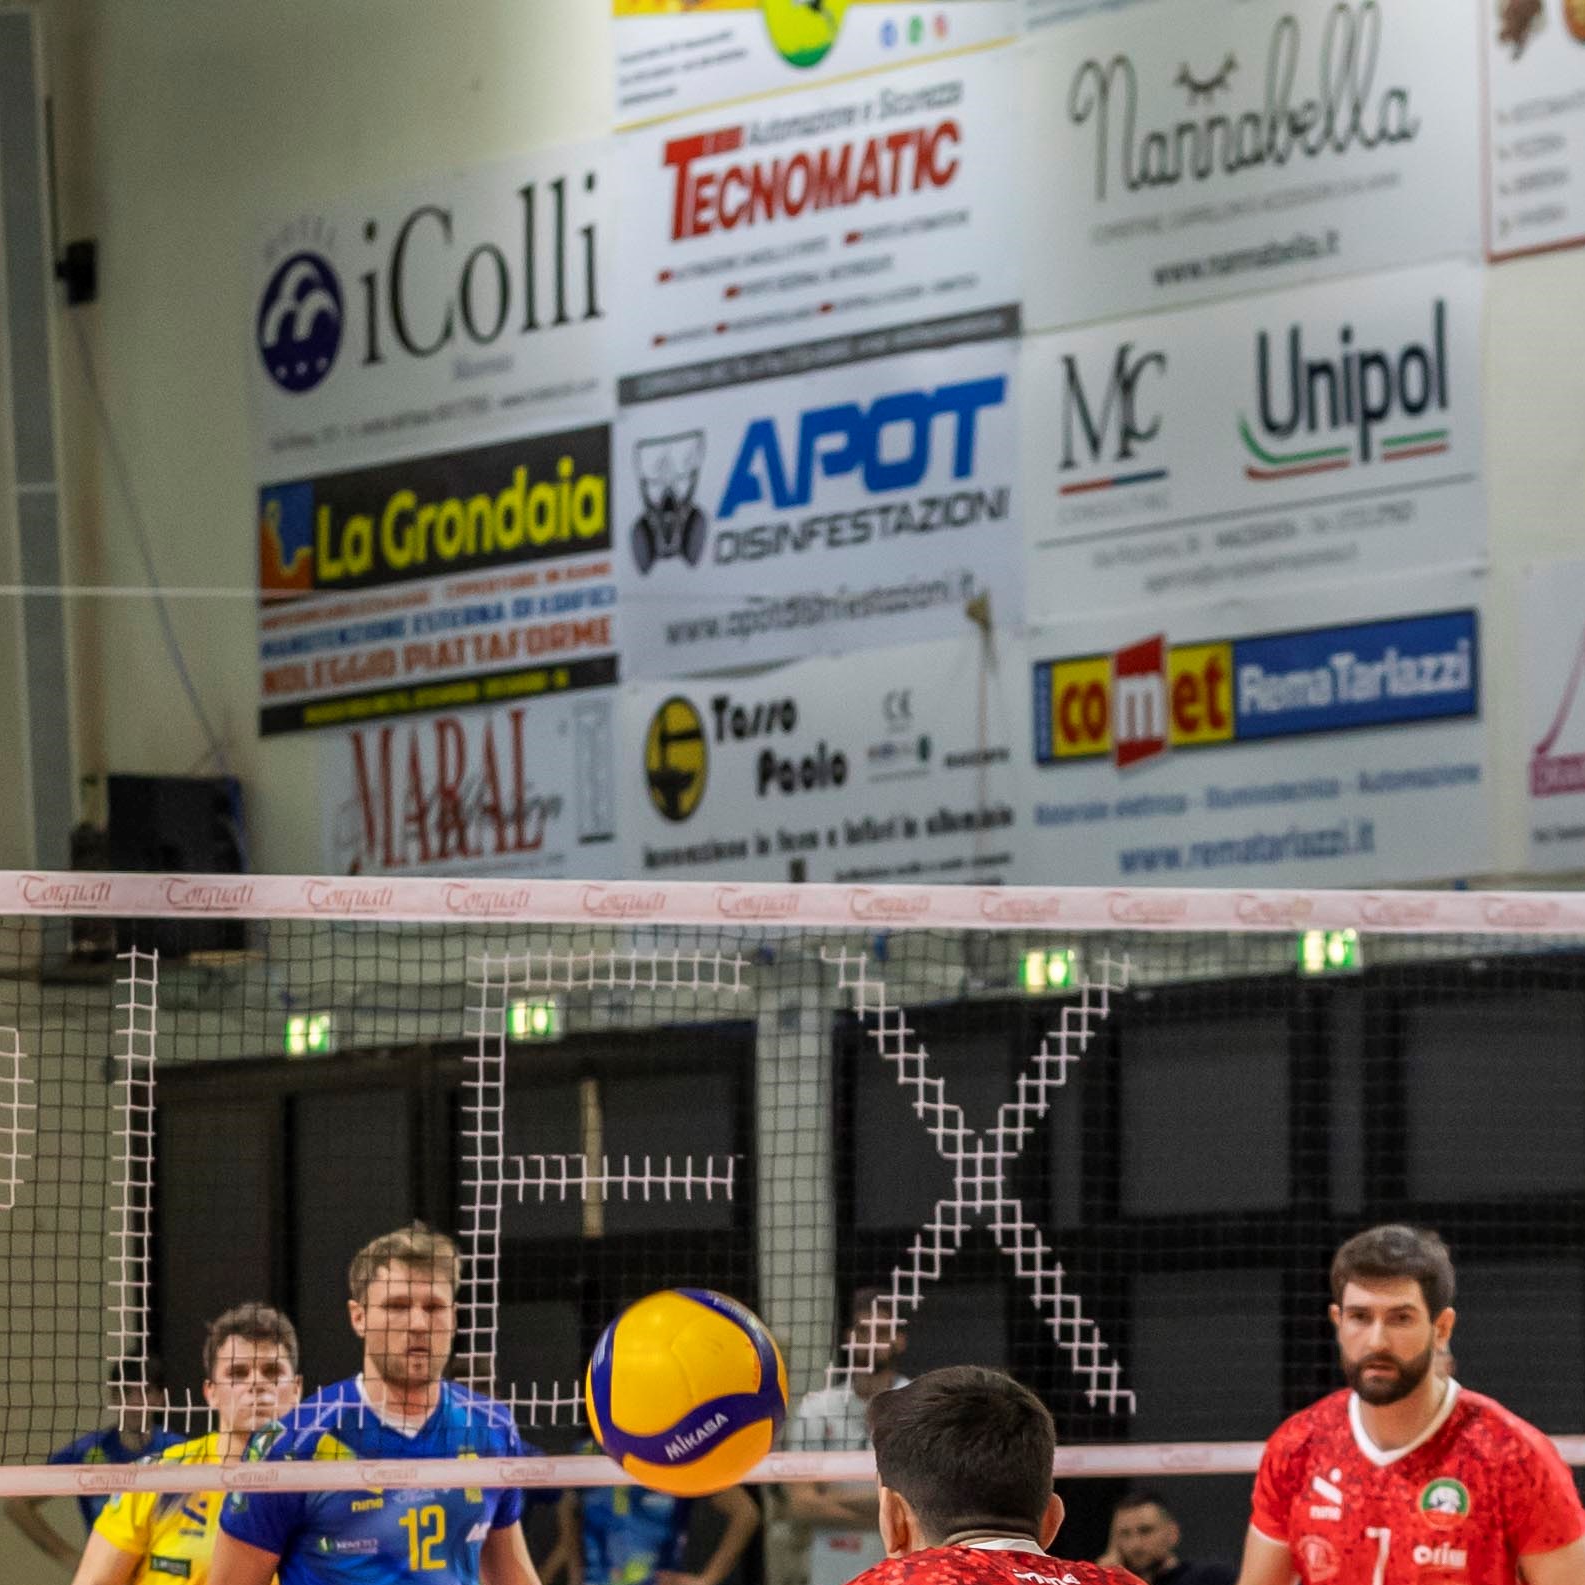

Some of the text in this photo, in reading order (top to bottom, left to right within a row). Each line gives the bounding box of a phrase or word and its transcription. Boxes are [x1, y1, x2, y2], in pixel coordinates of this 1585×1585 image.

[1067, 1, 1420, 201] Nannabella
[662, 119, 963, 243] TECNOMATIC
[361, 171, 605, 367] iColli
[1255, 299, 1450, 463] Unipol
[717, 374, 1008, 520] APOT
[318, 456, 608, 581] La Grondaia
[715, 486, 1012, 565] DISINFESTAZIONI
[1058, 654, 1227, 746] comet
[665, 1412, 728, 1460] MIKASA
[399, 1504, 447, 1573] 12
